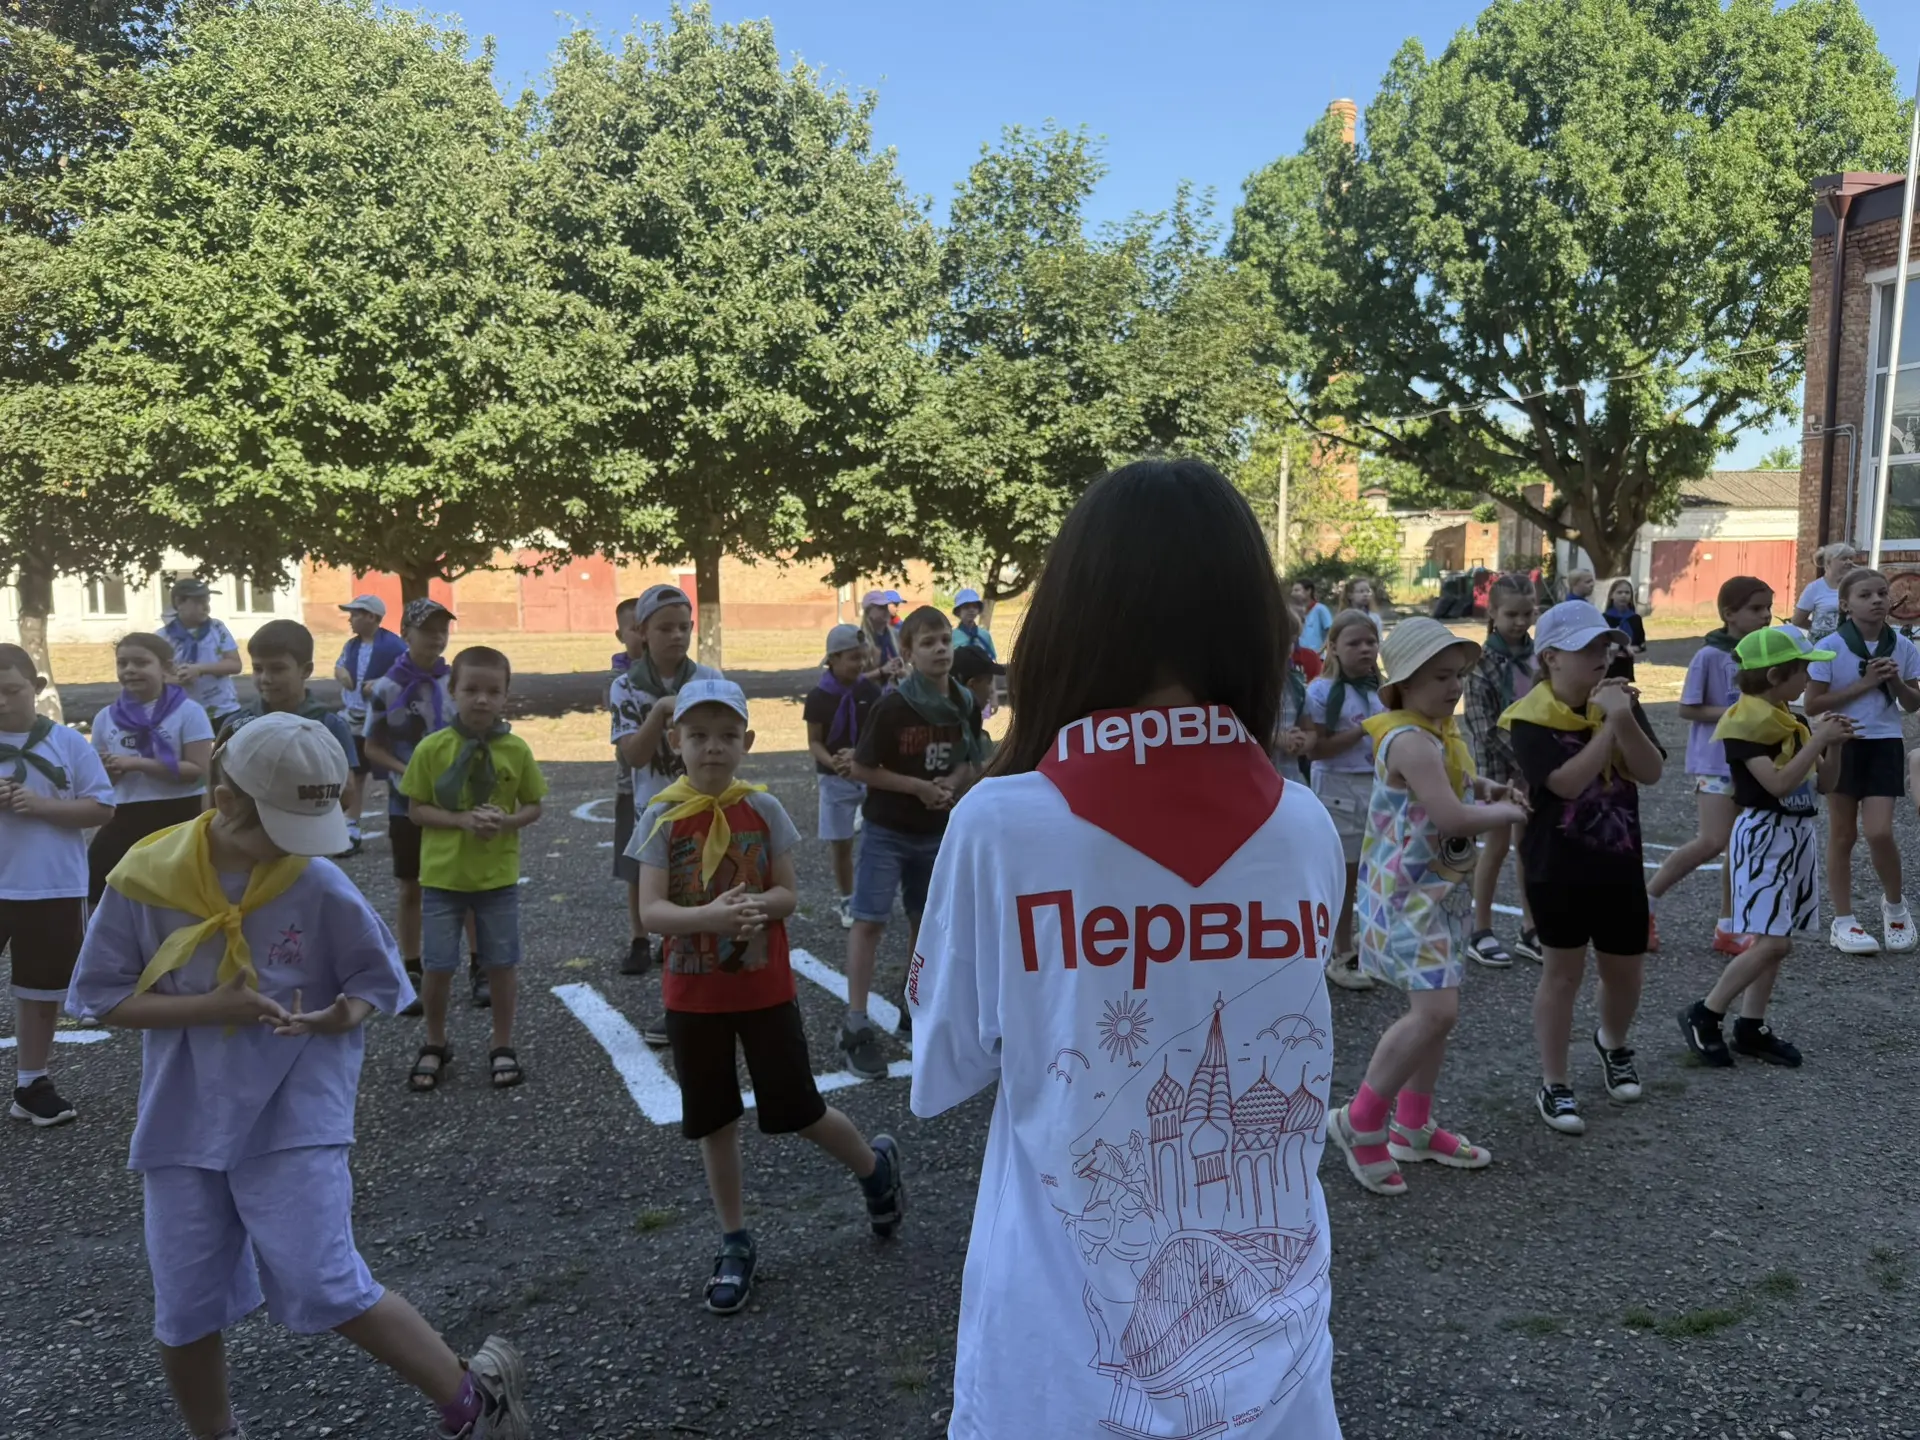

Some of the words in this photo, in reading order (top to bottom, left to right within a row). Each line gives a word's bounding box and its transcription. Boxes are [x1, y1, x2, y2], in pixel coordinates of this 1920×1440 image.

[1058, 705, 1258, 765] Первы
[925, 742, 952, 771] 85
[1232, 1406, 1261, 1421] ЕДИНСТВО
